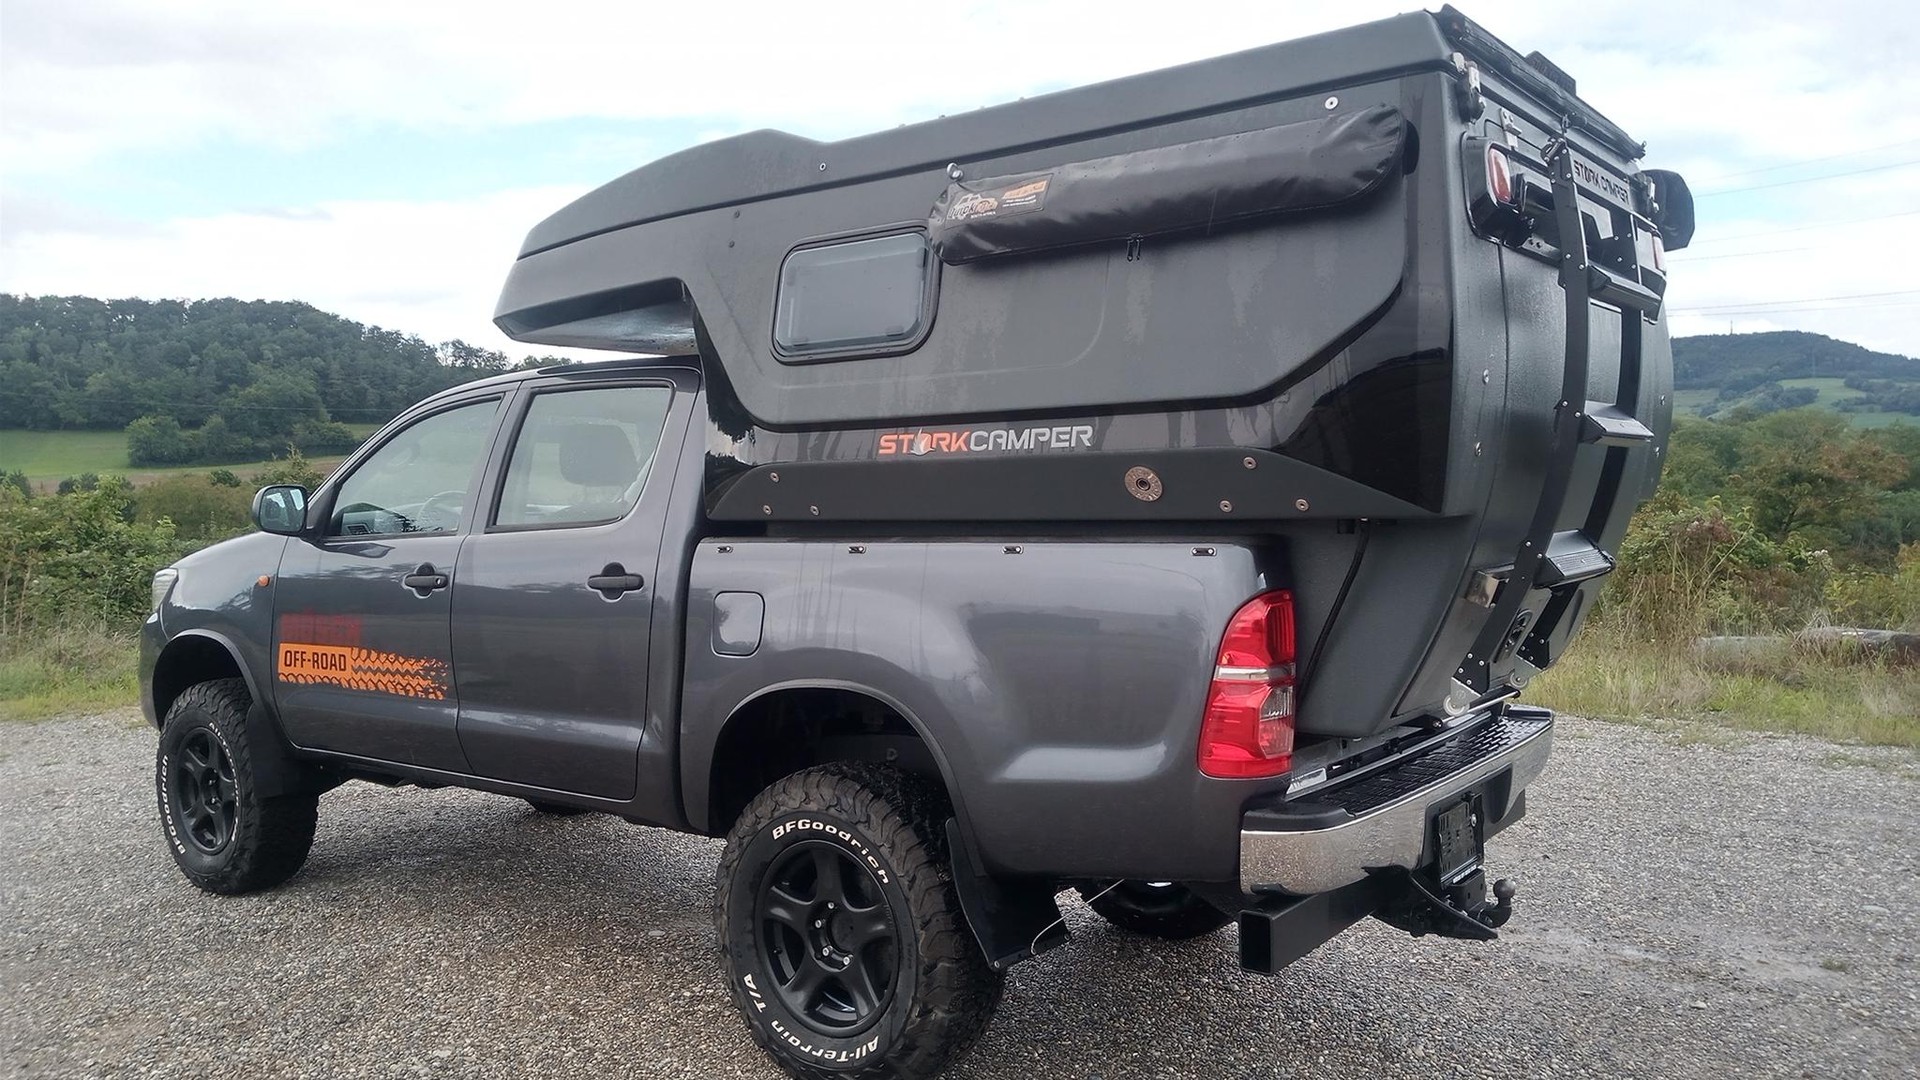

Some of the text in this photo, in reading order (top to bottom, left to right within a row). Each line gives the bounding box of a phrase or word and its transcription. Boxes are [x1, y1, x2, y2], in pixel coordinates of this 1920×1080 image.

[283, 649, 347, 672] OFF-ROAD
[161, 754, 186, 855] BFGoodrich
[771, 818, 889, 884] BFGoodrich
[743, 973, 880, 1063] All-Terrain T/A
